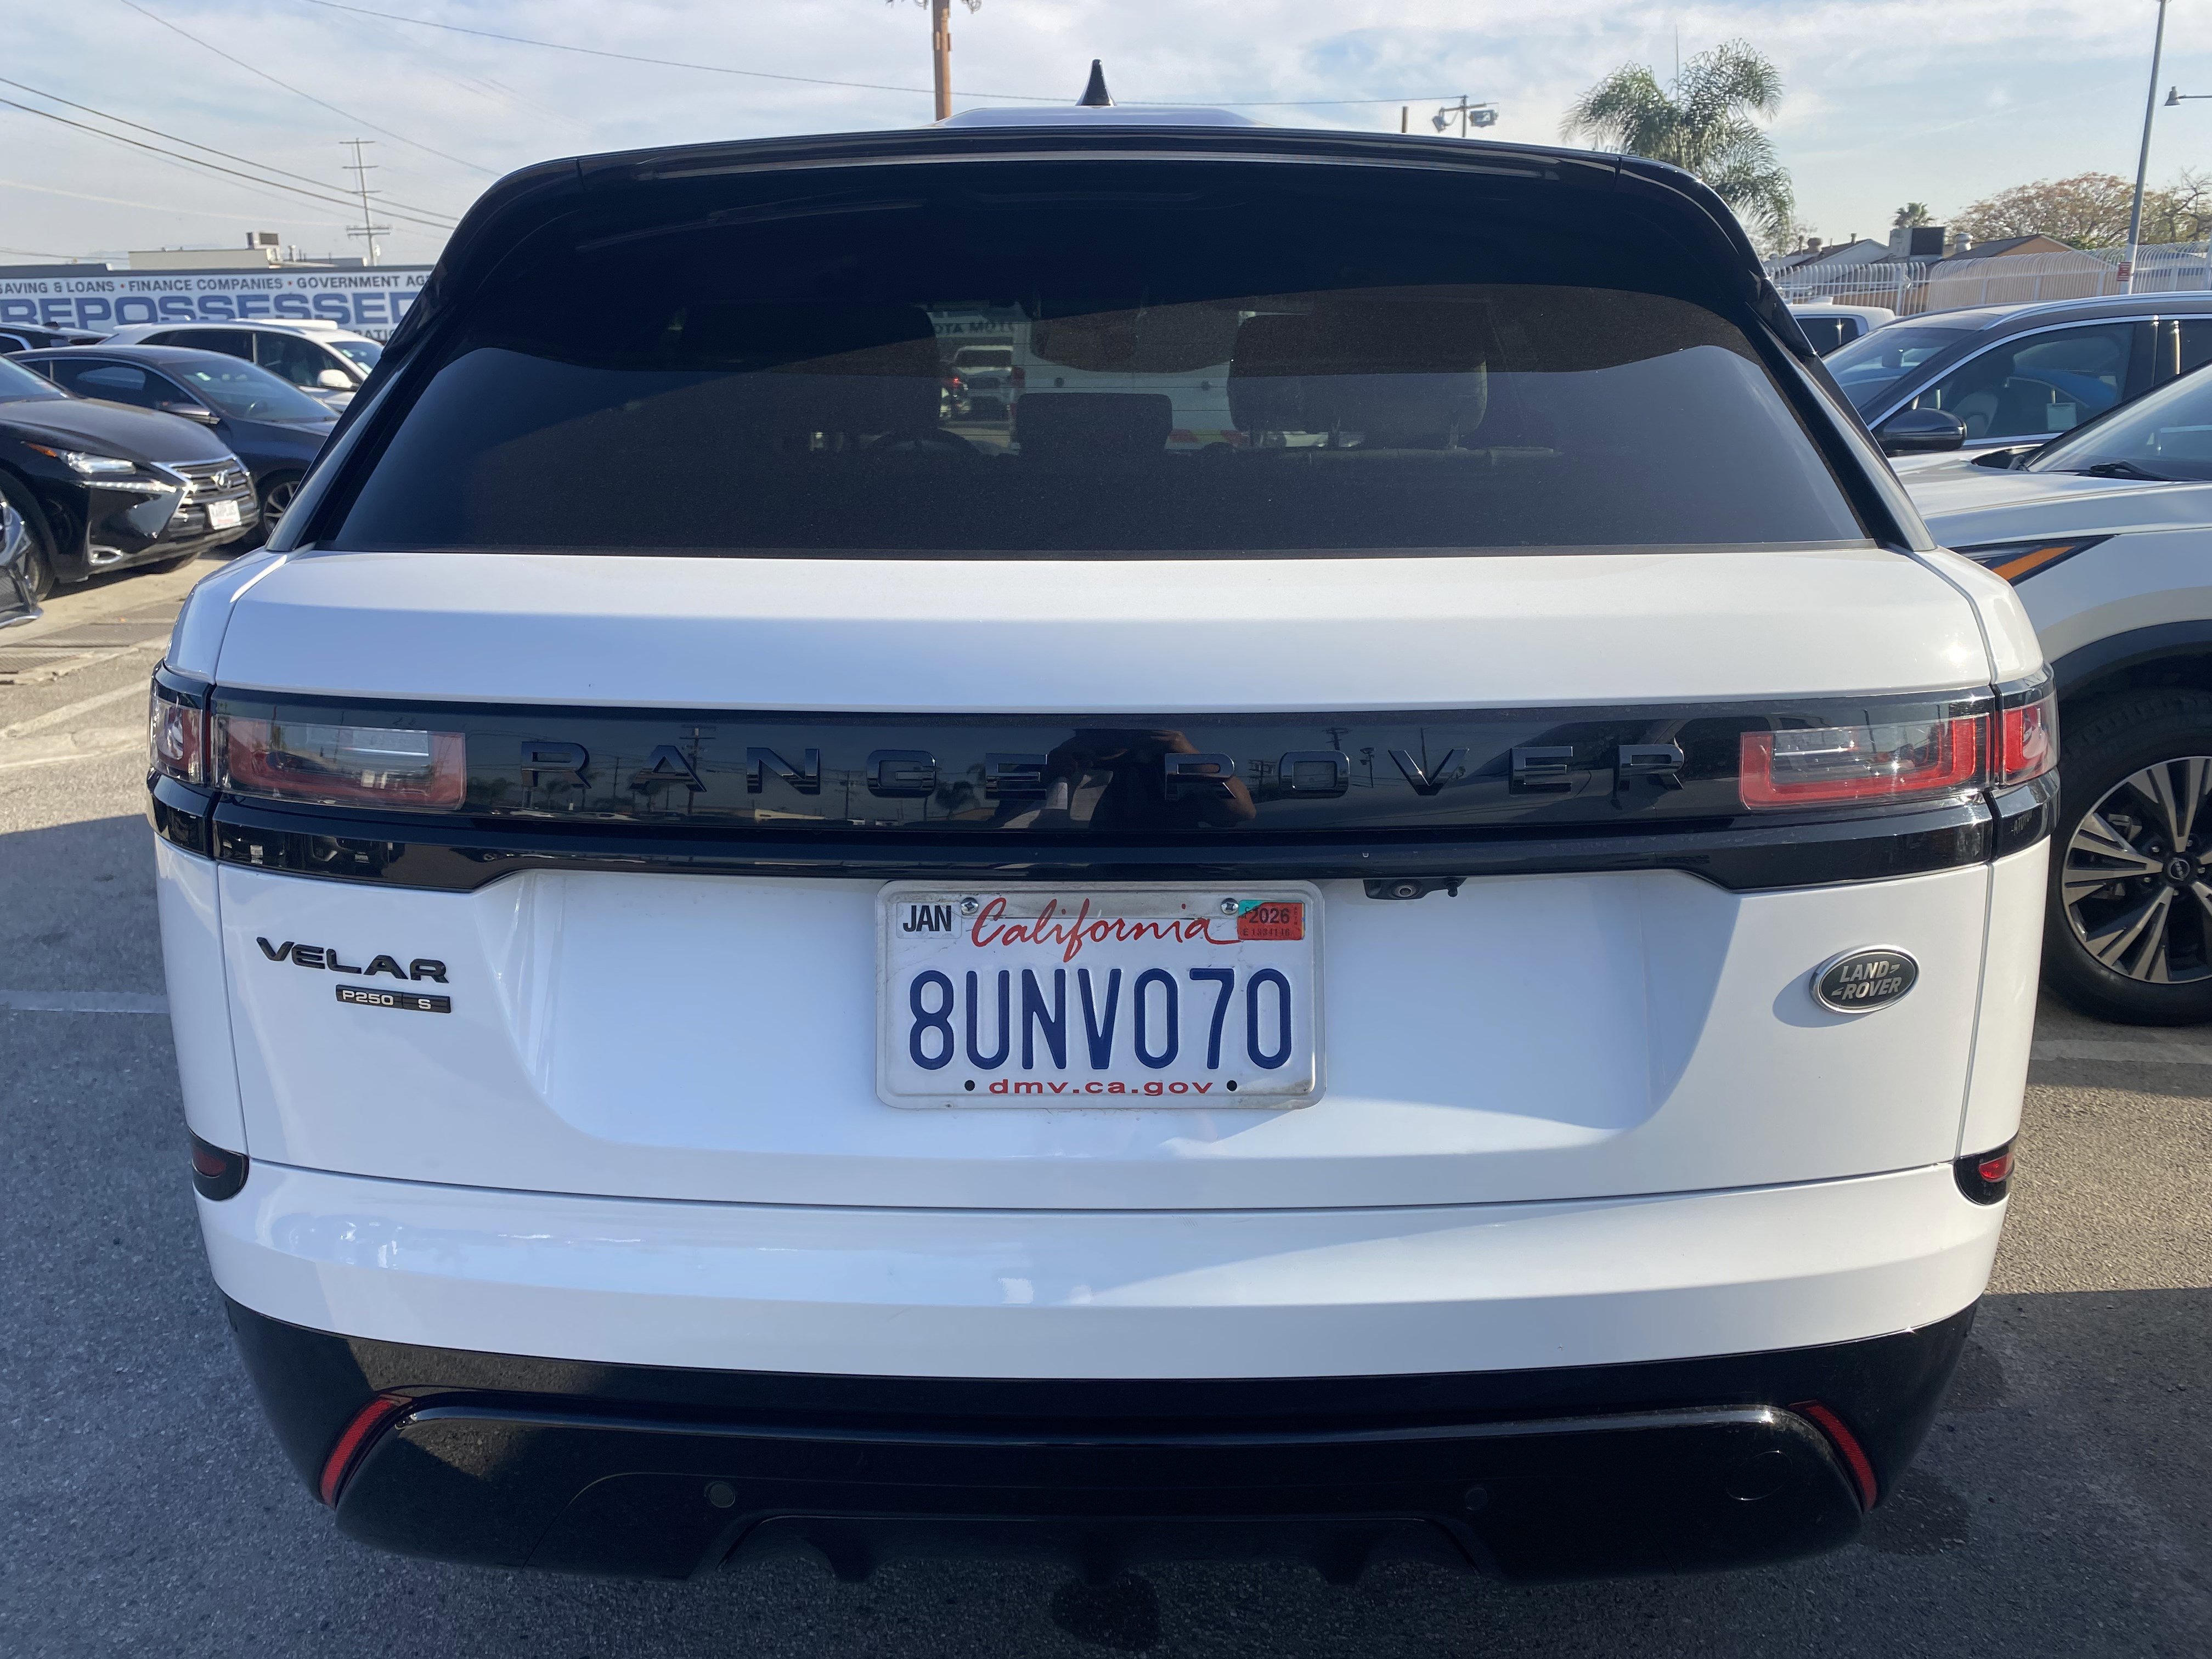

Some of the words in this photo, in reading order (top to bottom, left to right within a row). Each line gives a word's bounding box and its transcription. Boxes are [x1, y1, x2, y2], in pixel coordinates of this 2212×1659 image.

[0, 282, 48, 294] AVING
[67, 281, 115, 292] LOANS
[128, 279, 192, 292] FINANCE
[196, 278, 283, 291] COMPANIES
[297, 275, 400, 289] GOVERNMENT
[521, 741, 1047, 802] RANGE
[1164, 744, 1685, 801] ROVER
[902, 905, 952, 933] JAN
[1249, 907, 1290, 924] 2026
[972, 898, 1244, 963] California
[256, 937, 449, 983] VELAR
[342, 990, 394, 1006] P250
[417, 998, 432, 1009] S
[1842, 977, 1903, 1000] ROVER
[910, 968, 1292, 1070] 8UNV070
[989, 1078, 1213, 1096] dmv.ca.gov
